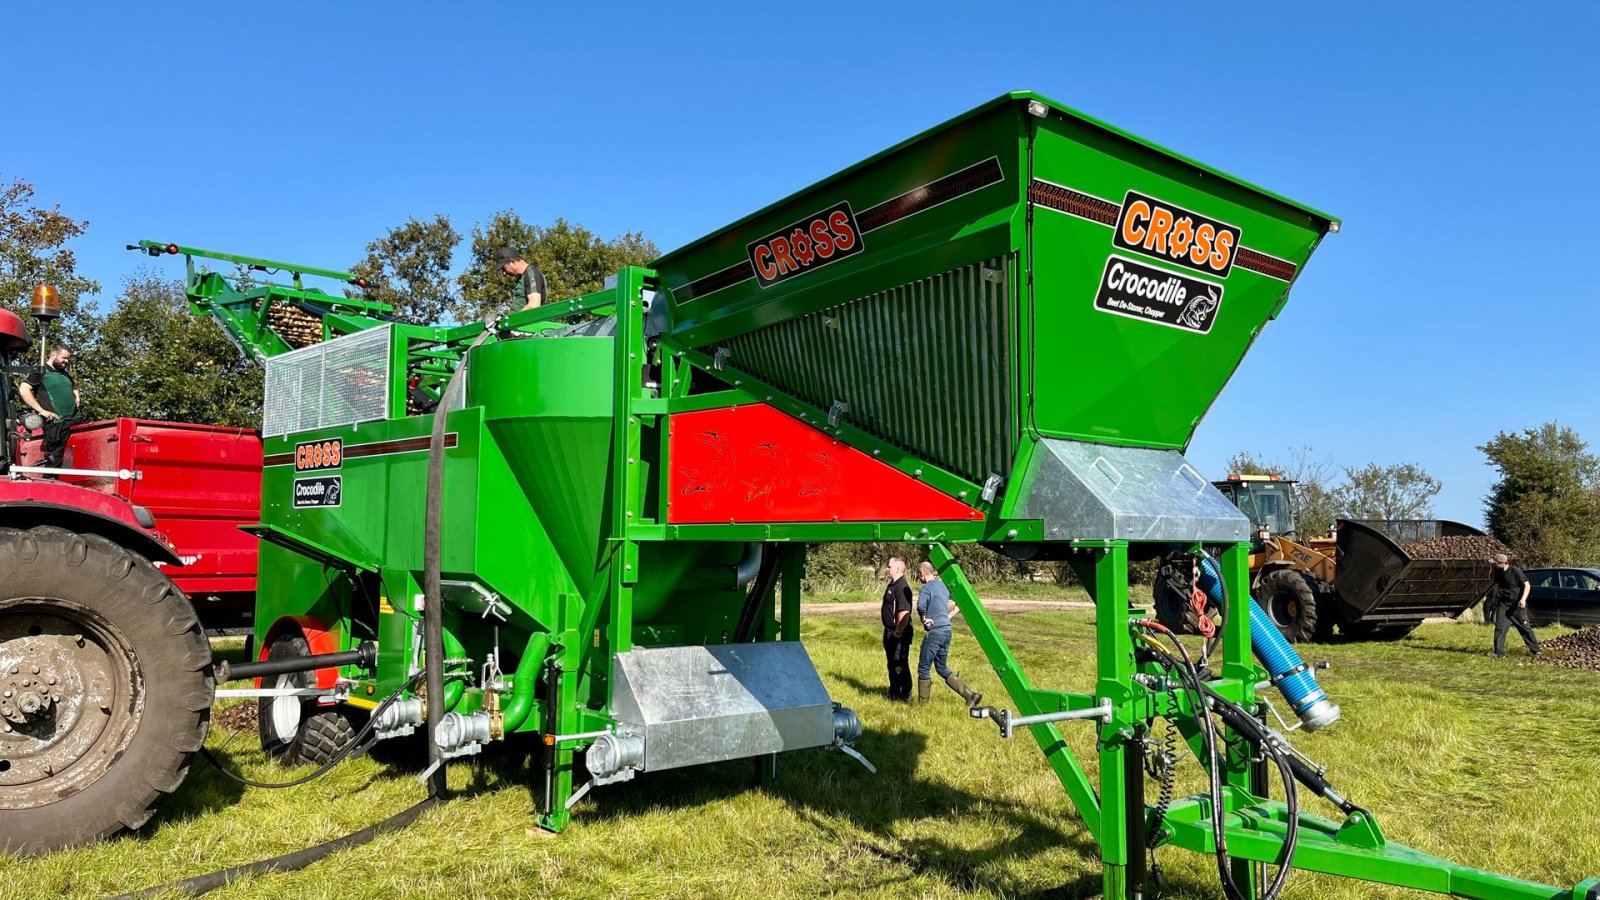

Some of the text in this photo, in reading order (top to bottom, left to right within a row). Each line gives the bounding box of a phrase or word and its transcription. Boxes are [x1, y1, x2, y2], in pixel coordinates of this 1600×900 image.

[754, 211, 855, 280] CROSS
[1122, 200, 1234, 270] CROSS
[1107, 262, 1187, 306] Crocodile
[1144, 306, 1166, 318] Chopper
[297, 441, 341, 470] CROSS
[296, 482, 325, 497] Crocodile
